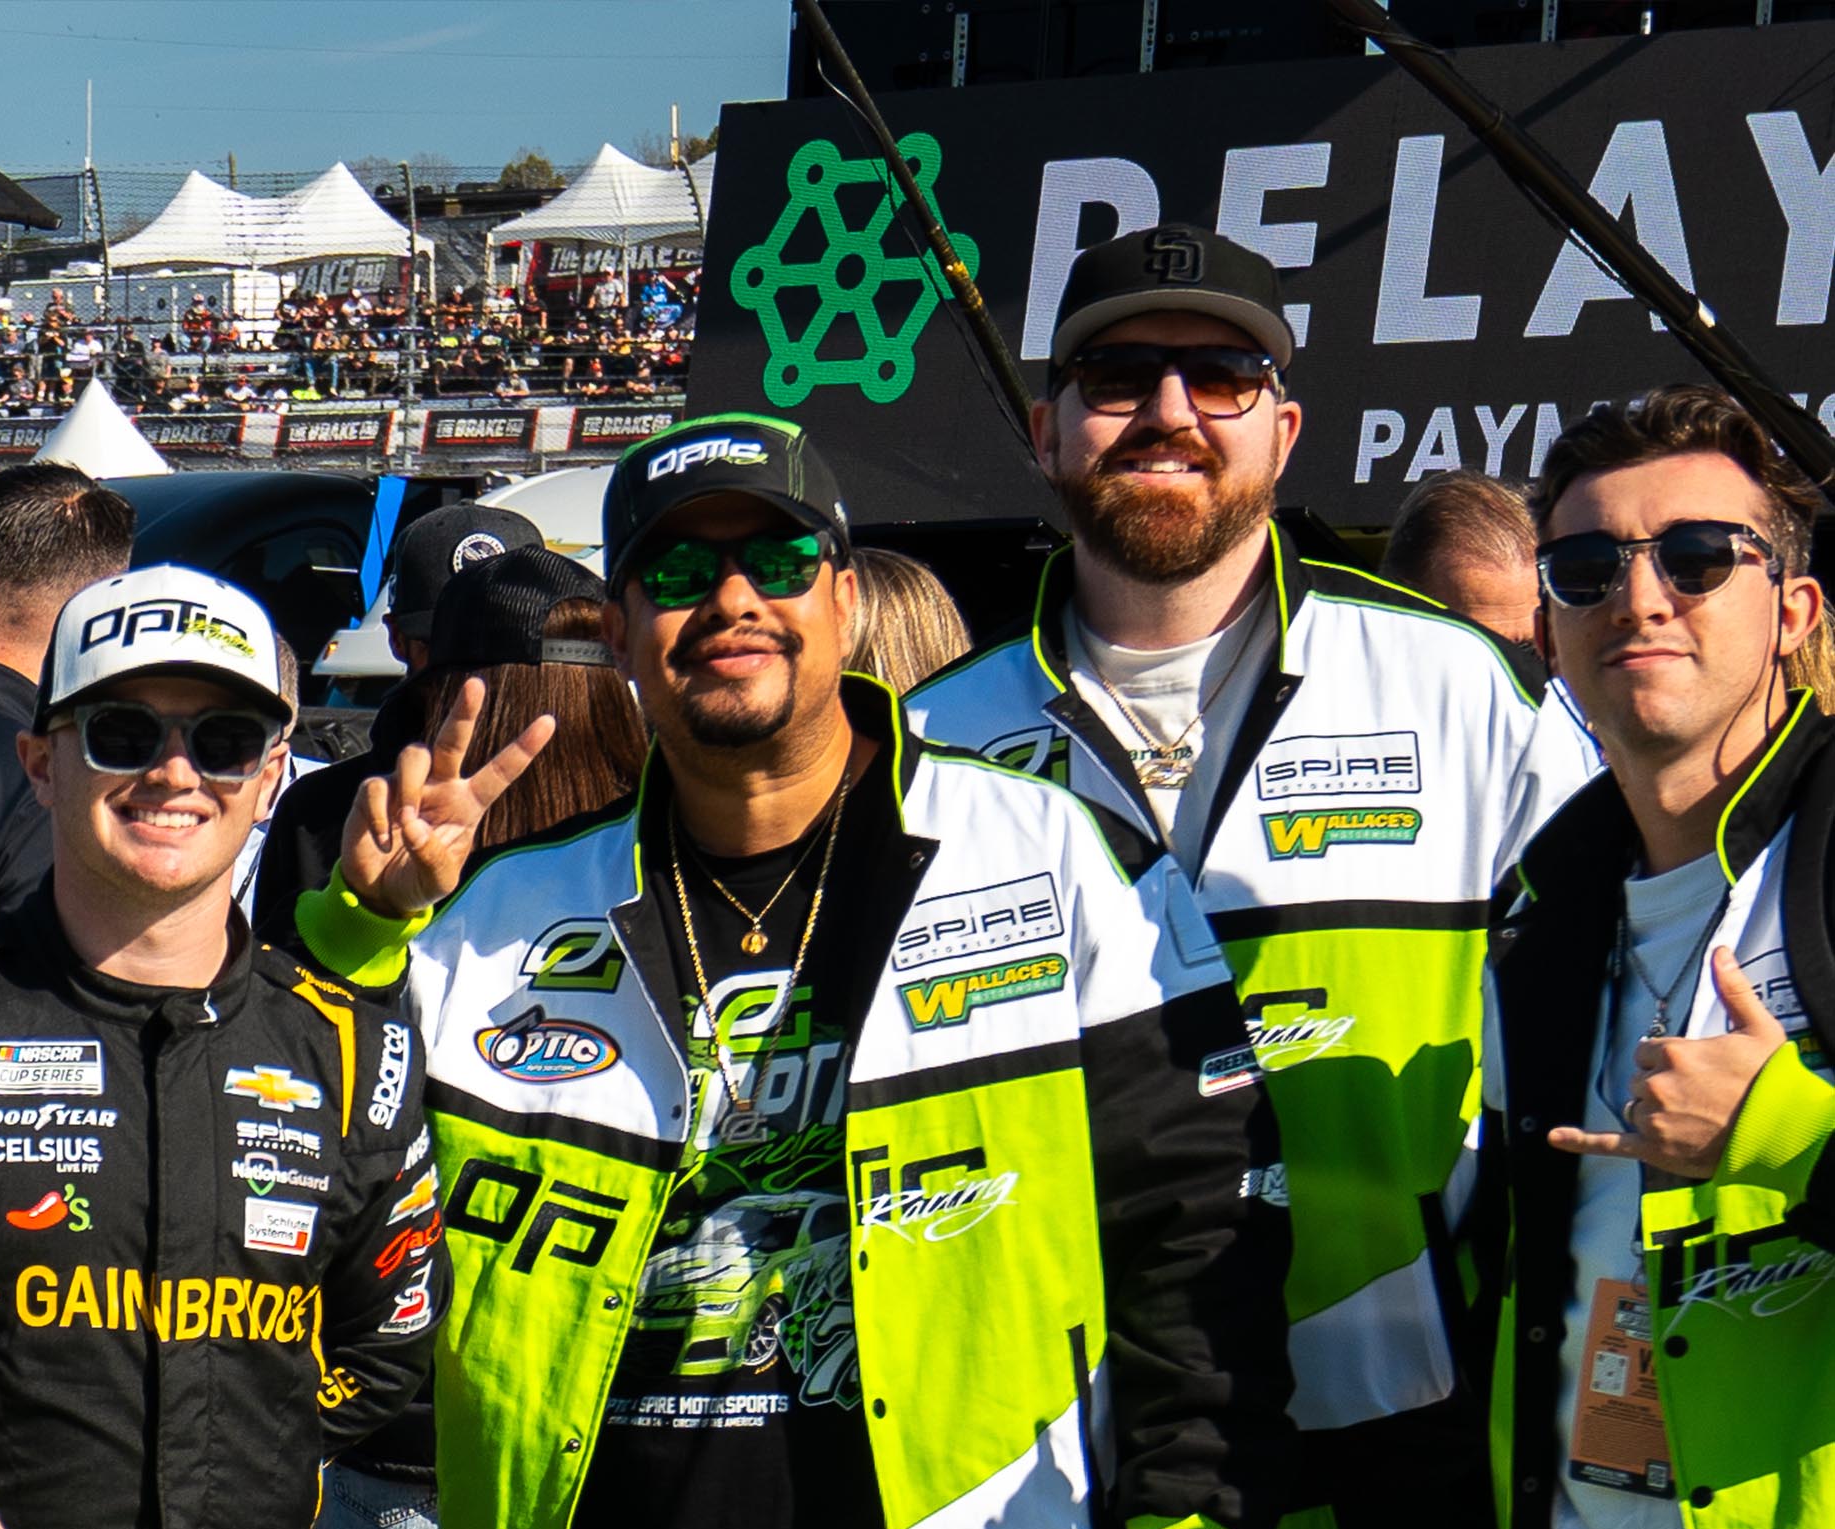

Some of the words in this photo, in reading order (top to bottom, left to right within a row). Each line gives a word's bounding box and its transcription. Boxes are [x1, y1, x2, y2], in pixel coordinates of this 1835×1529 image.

[1019, 110, 1835, 361] RELAY
[453, 418, 505, 438] BRAKE
[601, 415, 652, 435] BRAKE
[1265, 743, 1413, 782] SPIRE
[898, 899, 1054, 952] SPIRE
[18, 1046, 84, 1062] NASCAR
[0, 1068, 31, 1082] CUP
[31, 1068, 84, 1082] SERIES
[367, 1022, 409, 1131] sparco
[236, 1117, 321, 1151] SPIRE
[56, 1163, 81, 1173] LIVE
[81, 1162, 100, 1173] FIT
[232, 1160, 329, 1192] NationsGuard
[857, 1171, 1021, 1245] Racing
[248, 1224, 295, 1242] Systems
[679, 1394, 790, 1415] MOTORSPORTS
